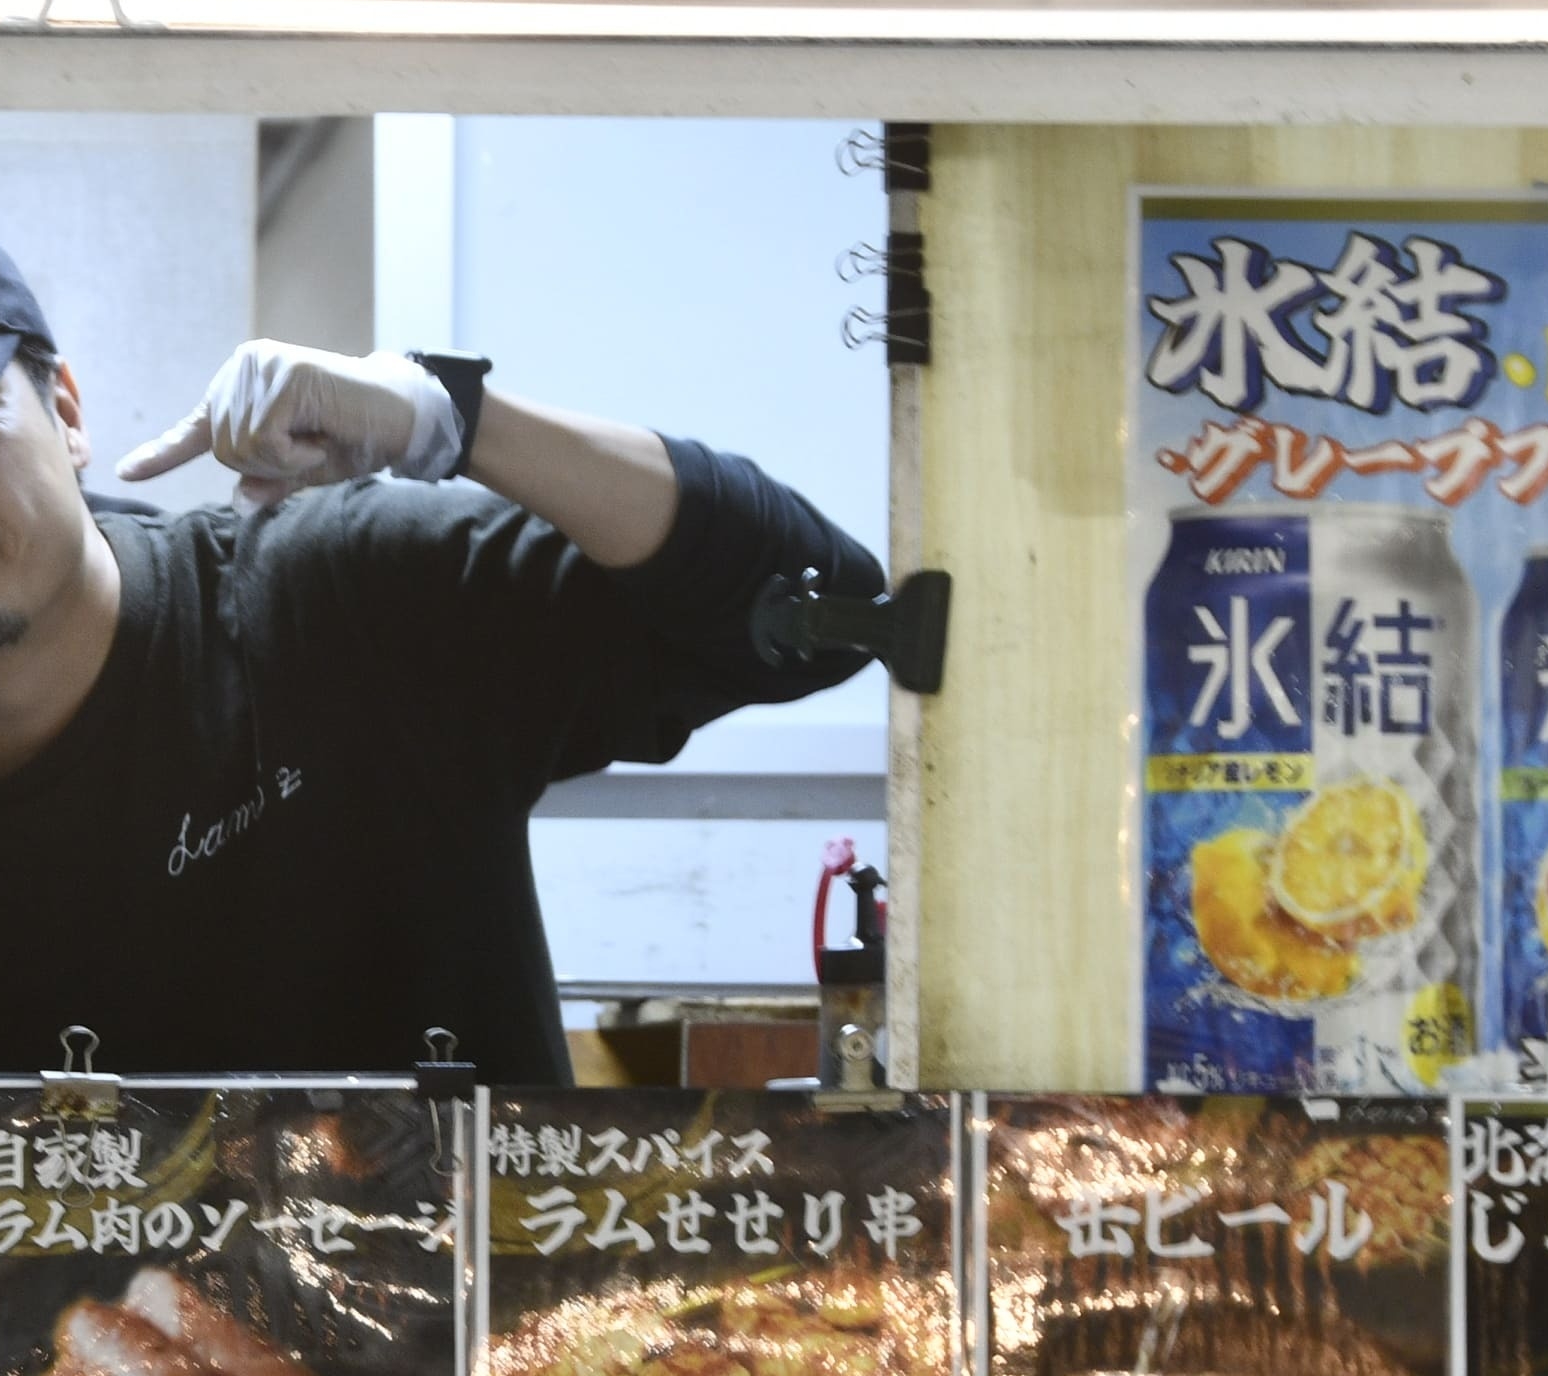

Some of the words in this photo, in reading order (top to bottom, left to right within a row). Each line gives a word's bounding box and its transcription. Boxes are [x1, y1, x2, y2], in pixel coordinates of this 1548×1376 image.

[1147, 229, 1508, 416] 氷結
[1205, 545, 1286, 575] KIRIN
[1187, 595, 1434, 740] 氷結
[487, 1123, 776, 1177] 特製スパイス
[519, 1184, 923, 1260] ラムせせり串
[1054, 1178, 1374, 1261] 缶ビール
